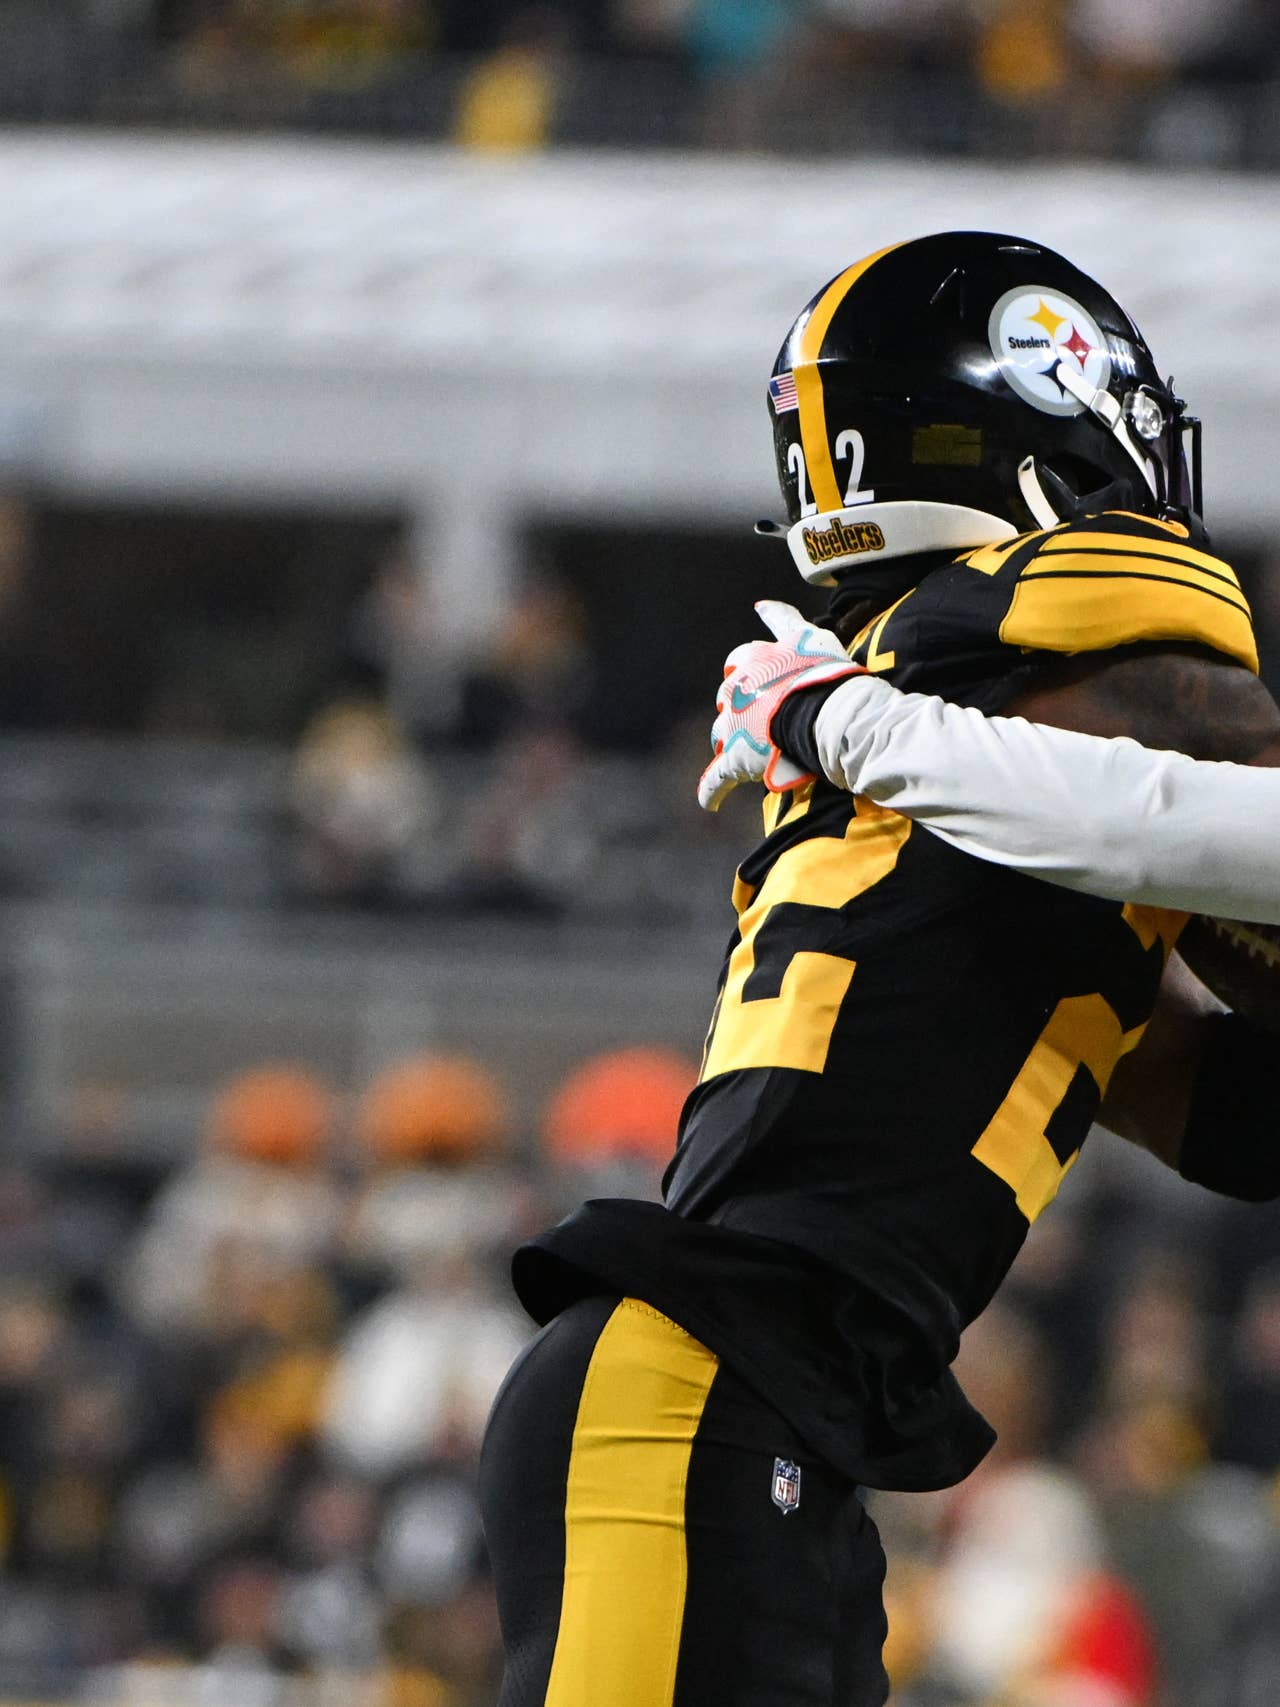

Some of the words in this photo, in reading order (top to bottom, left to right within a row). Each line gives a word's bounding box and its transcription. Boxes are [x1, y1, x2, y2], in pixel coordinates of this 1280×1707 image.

[1008, 336, 1051, 349] Steelers
[803, 518, 885, 565] Steelers
[775, 1476, 798, 1505] NFL
